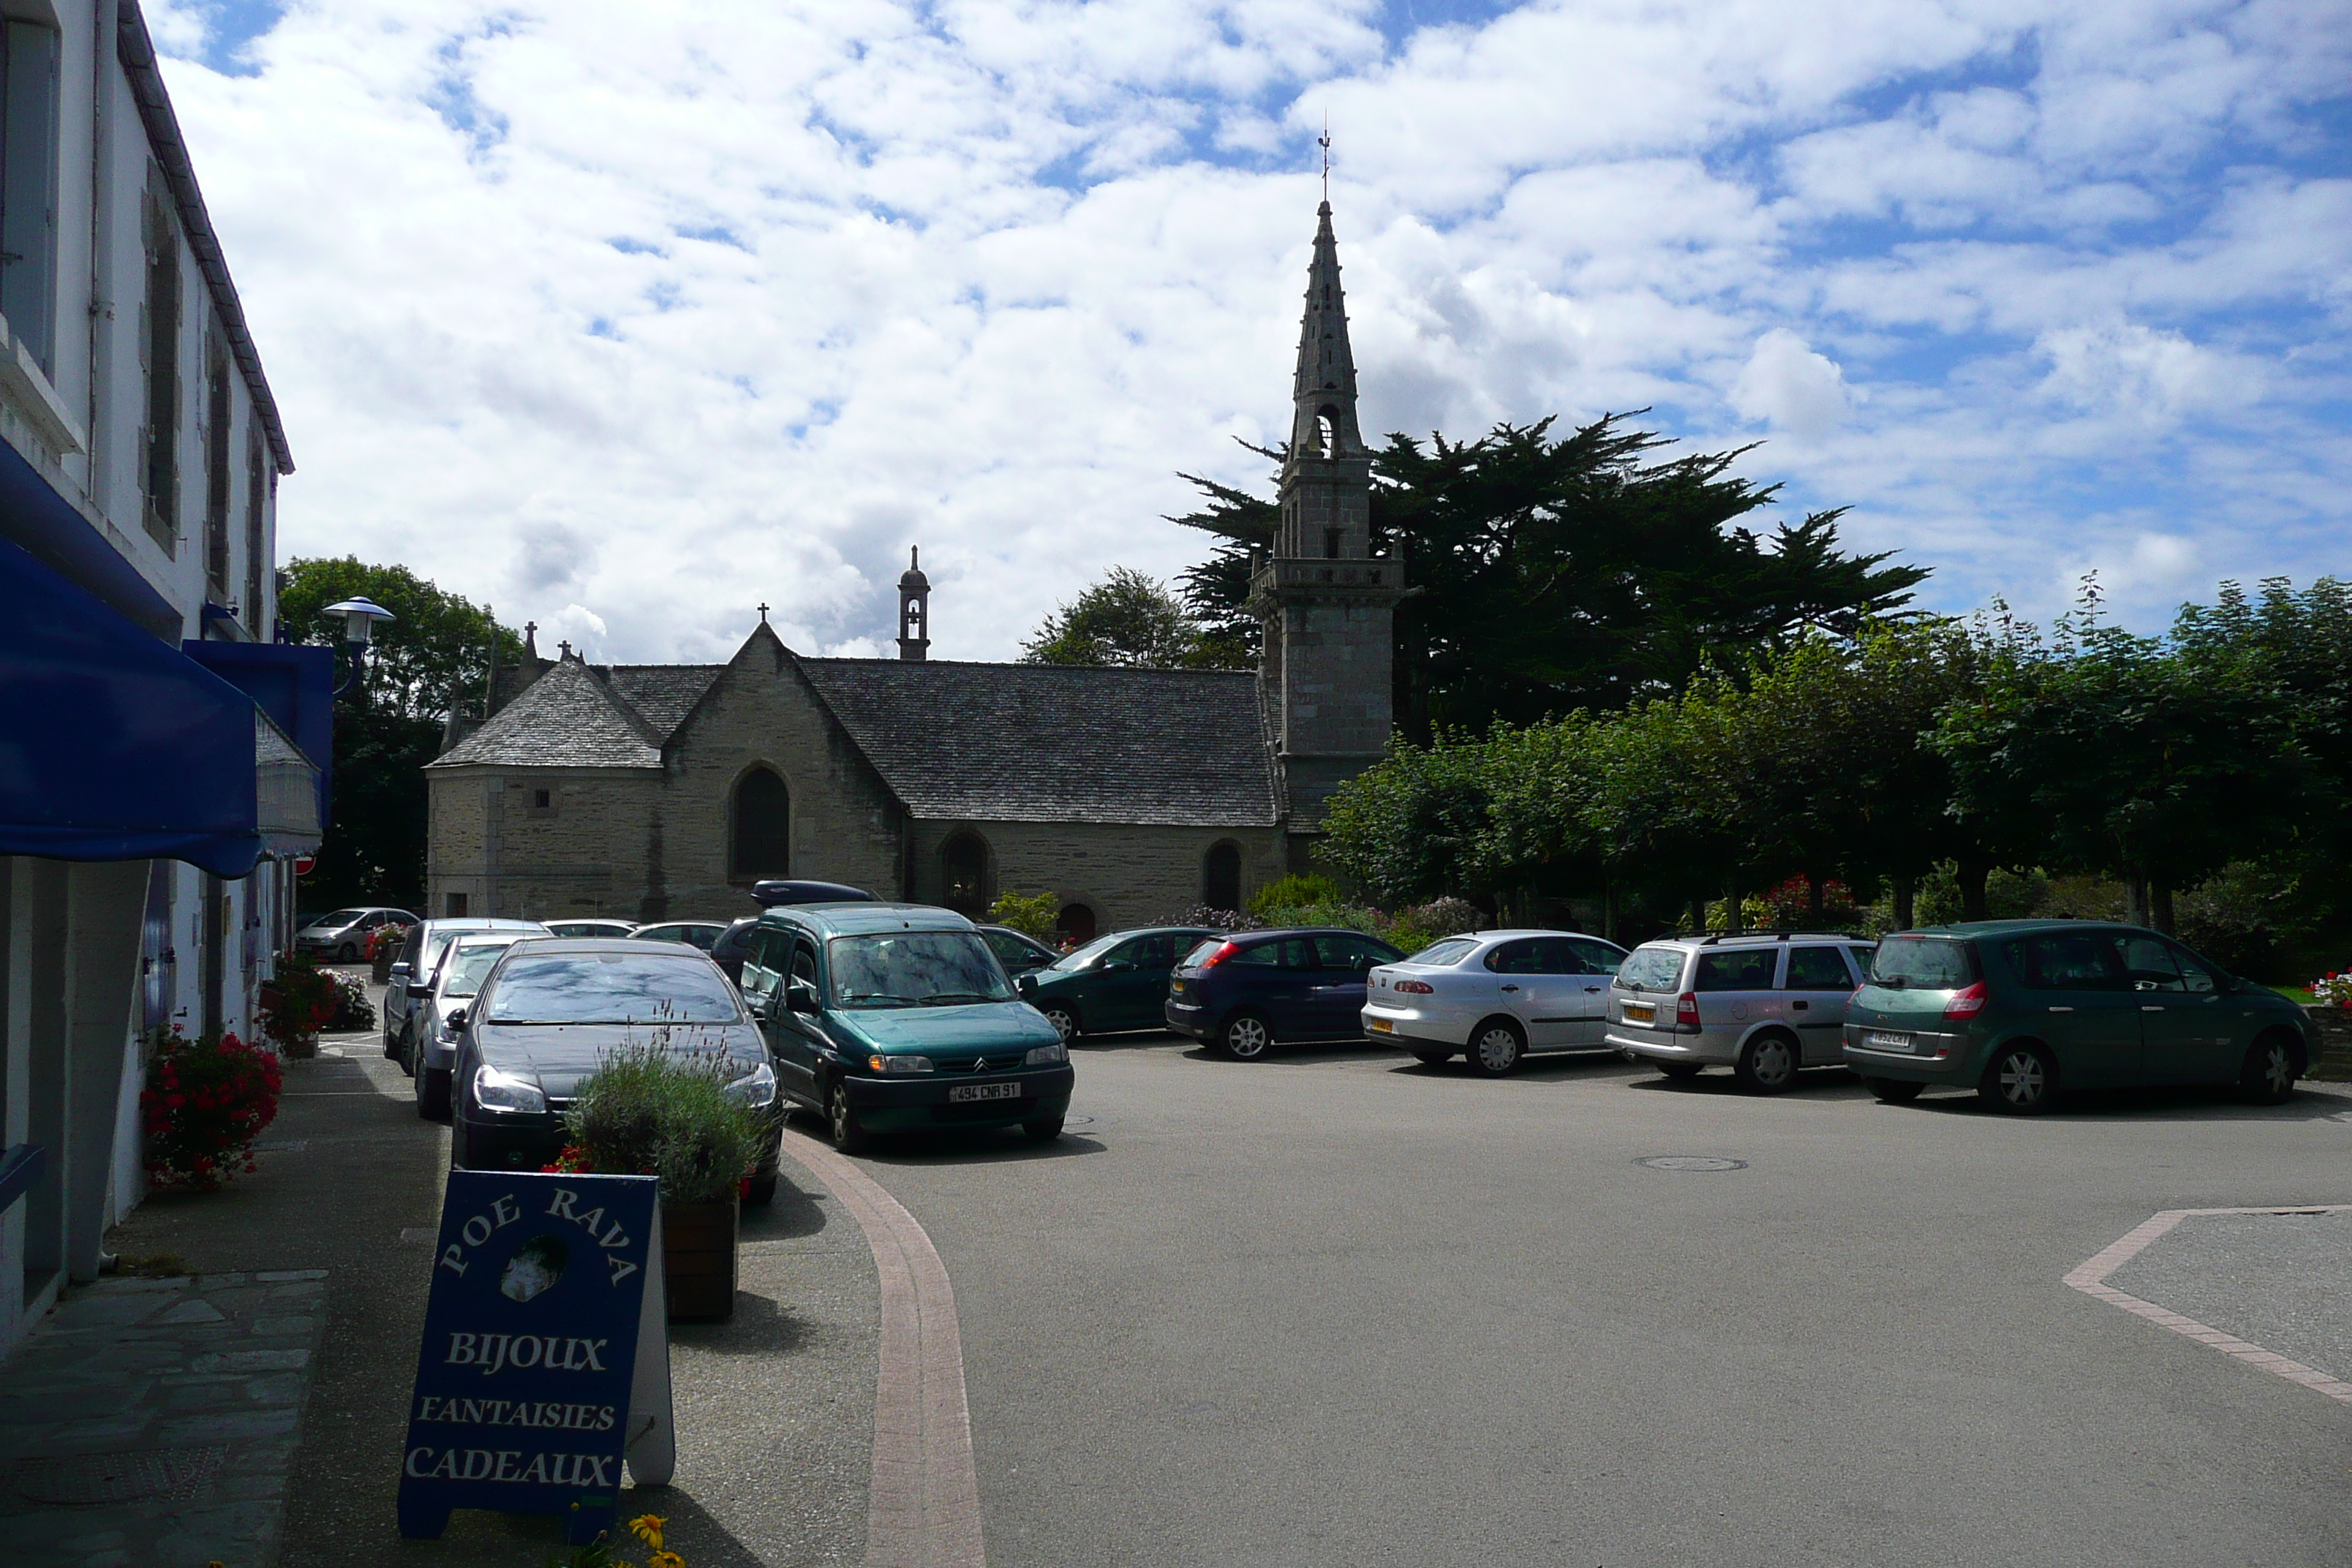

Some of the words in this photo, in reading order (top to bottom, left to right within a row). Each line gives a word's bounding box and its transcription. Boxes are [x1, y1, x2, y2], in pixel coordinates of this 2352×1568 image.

[958, 1087, 978, 1100] 494
[1003, 1084, 1016, 1097] 91
[440, 1193, 521, 1278] POE
[545, 1188, 638, 1287] RAVA
[445, 1332, 608, 1375] BIJOUX
[415, 1396, 615, 1431] FANTAISIES
[405, 1446, 614, 1487] CADEAUX
